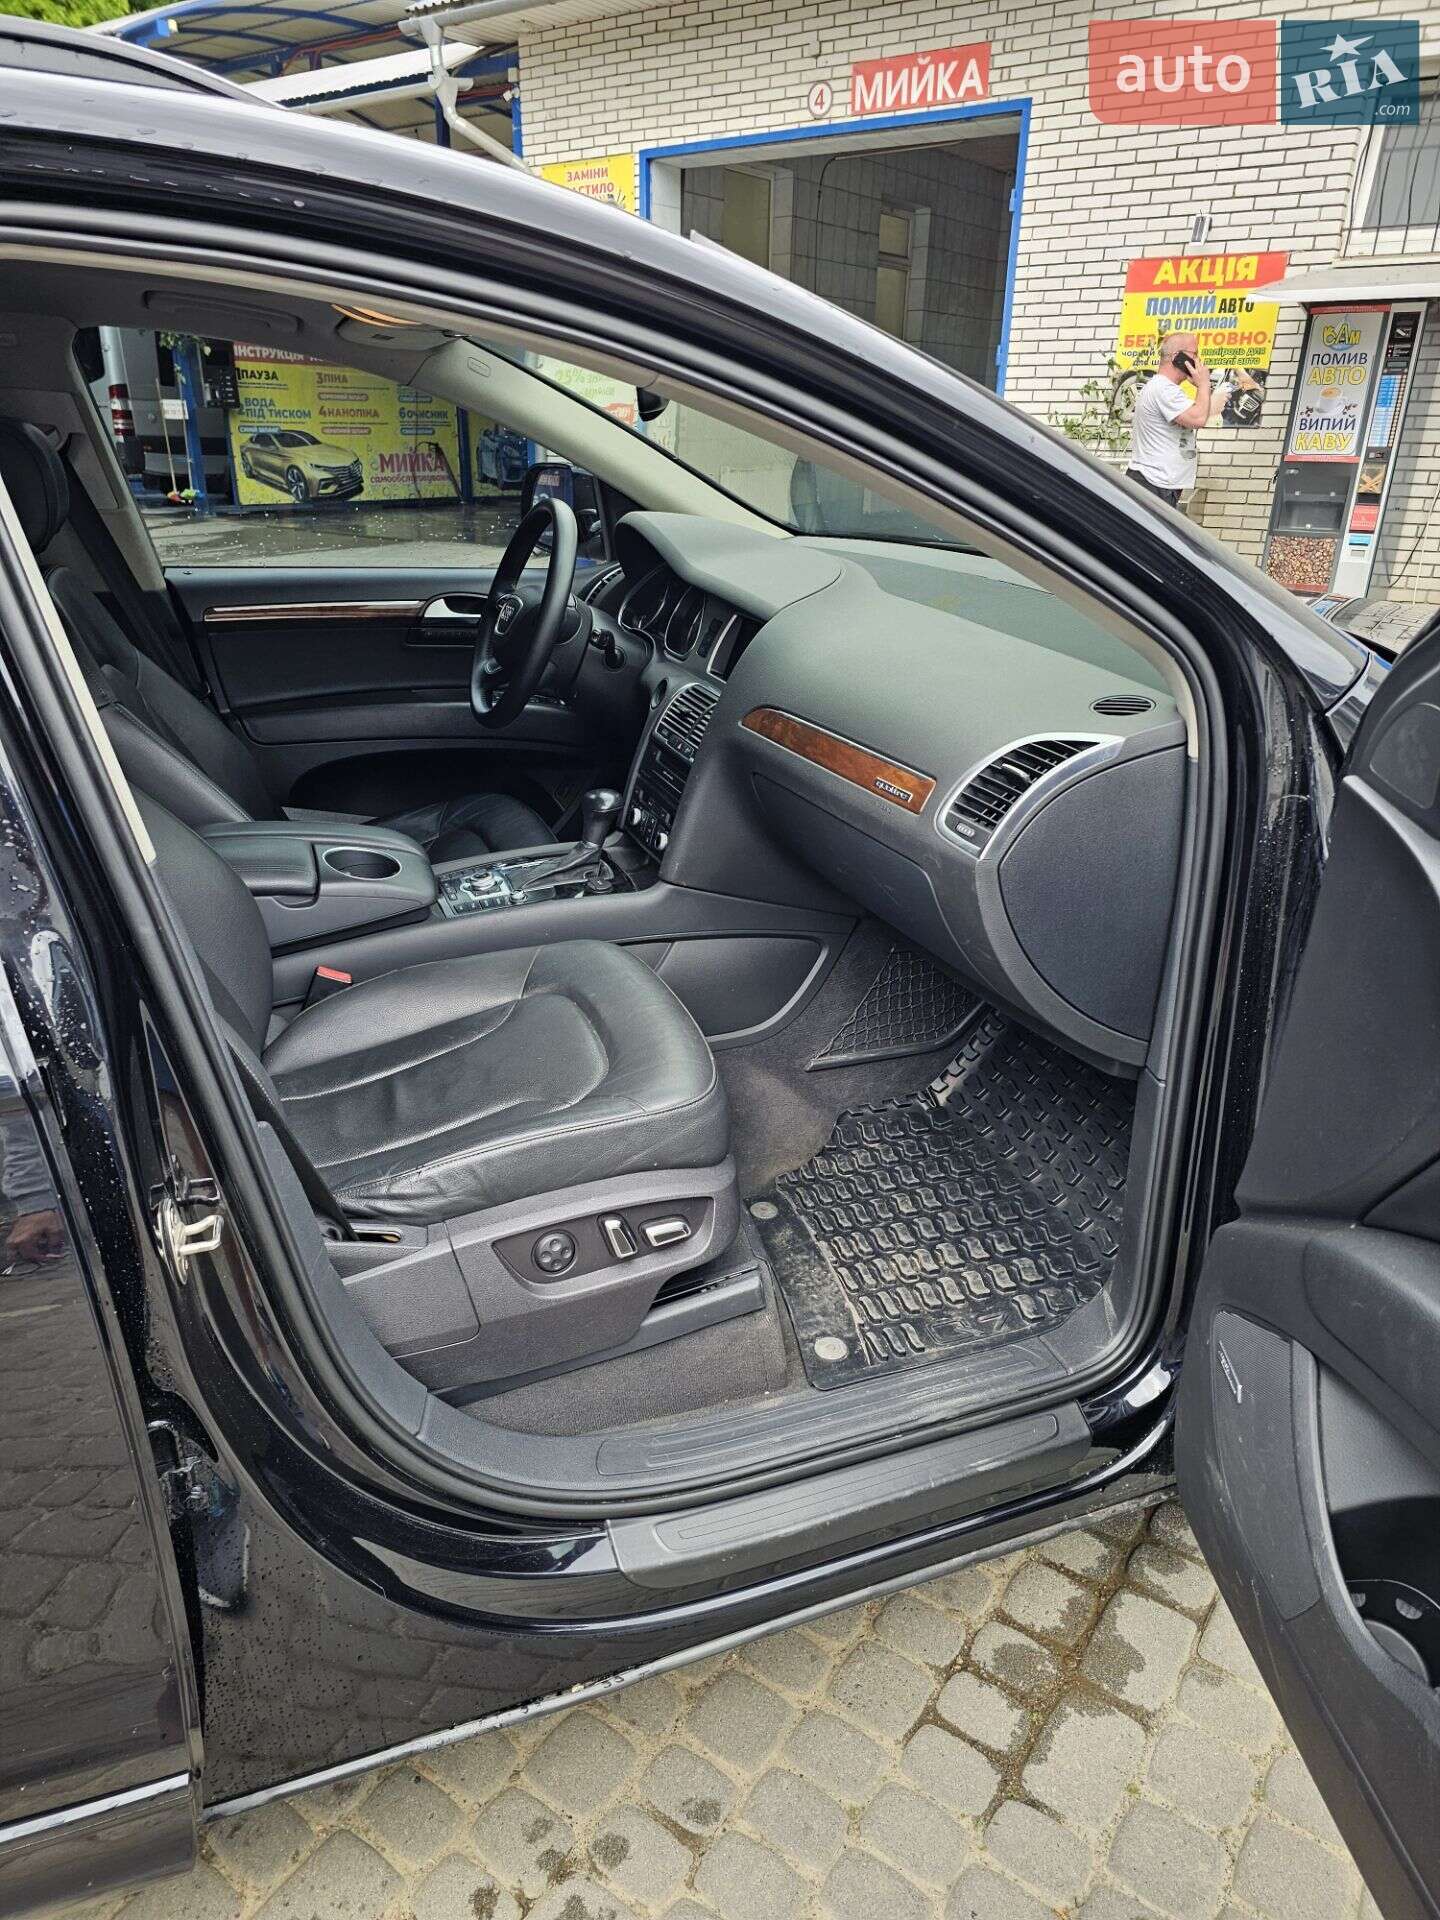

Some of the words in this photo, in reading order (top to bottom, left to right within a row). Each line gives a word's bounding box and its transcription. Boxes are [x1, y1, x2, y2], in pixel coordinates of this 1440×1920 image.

[854, 55, 984, 111] МИЙКА
[813, 88, 825, 110] 4
[567, 167, 609, 181] ЗАМІНИ
[1152, 255, 1259, 286] АКЦІЯ
[1146, 290, 1217, 316] ПОМИЙ
[1218, 297, 1255, 314] АВТО
[1174, 313, 1238, 332] отримай
[1311, 352, 1367, 366] ПОМИВ
[241, 369, 279, 381] ПАУЗА
[324, 374, 348, 384] ПІНА
[1307, 366, 1367, 386] АВТО
[244, 398, 275, 407] ВОДА
[245, 408, 265, 419] ПІД
[269, 409, 312, 419] ТИСКОМ
[327, 407, 379, 418] НАНОПІНА
[1299, 415, 1356, 431] ВИПИЙ
[1295, 432, 1352, 452] КАВУ
[379, 446, 445, 472] МИЙКА
